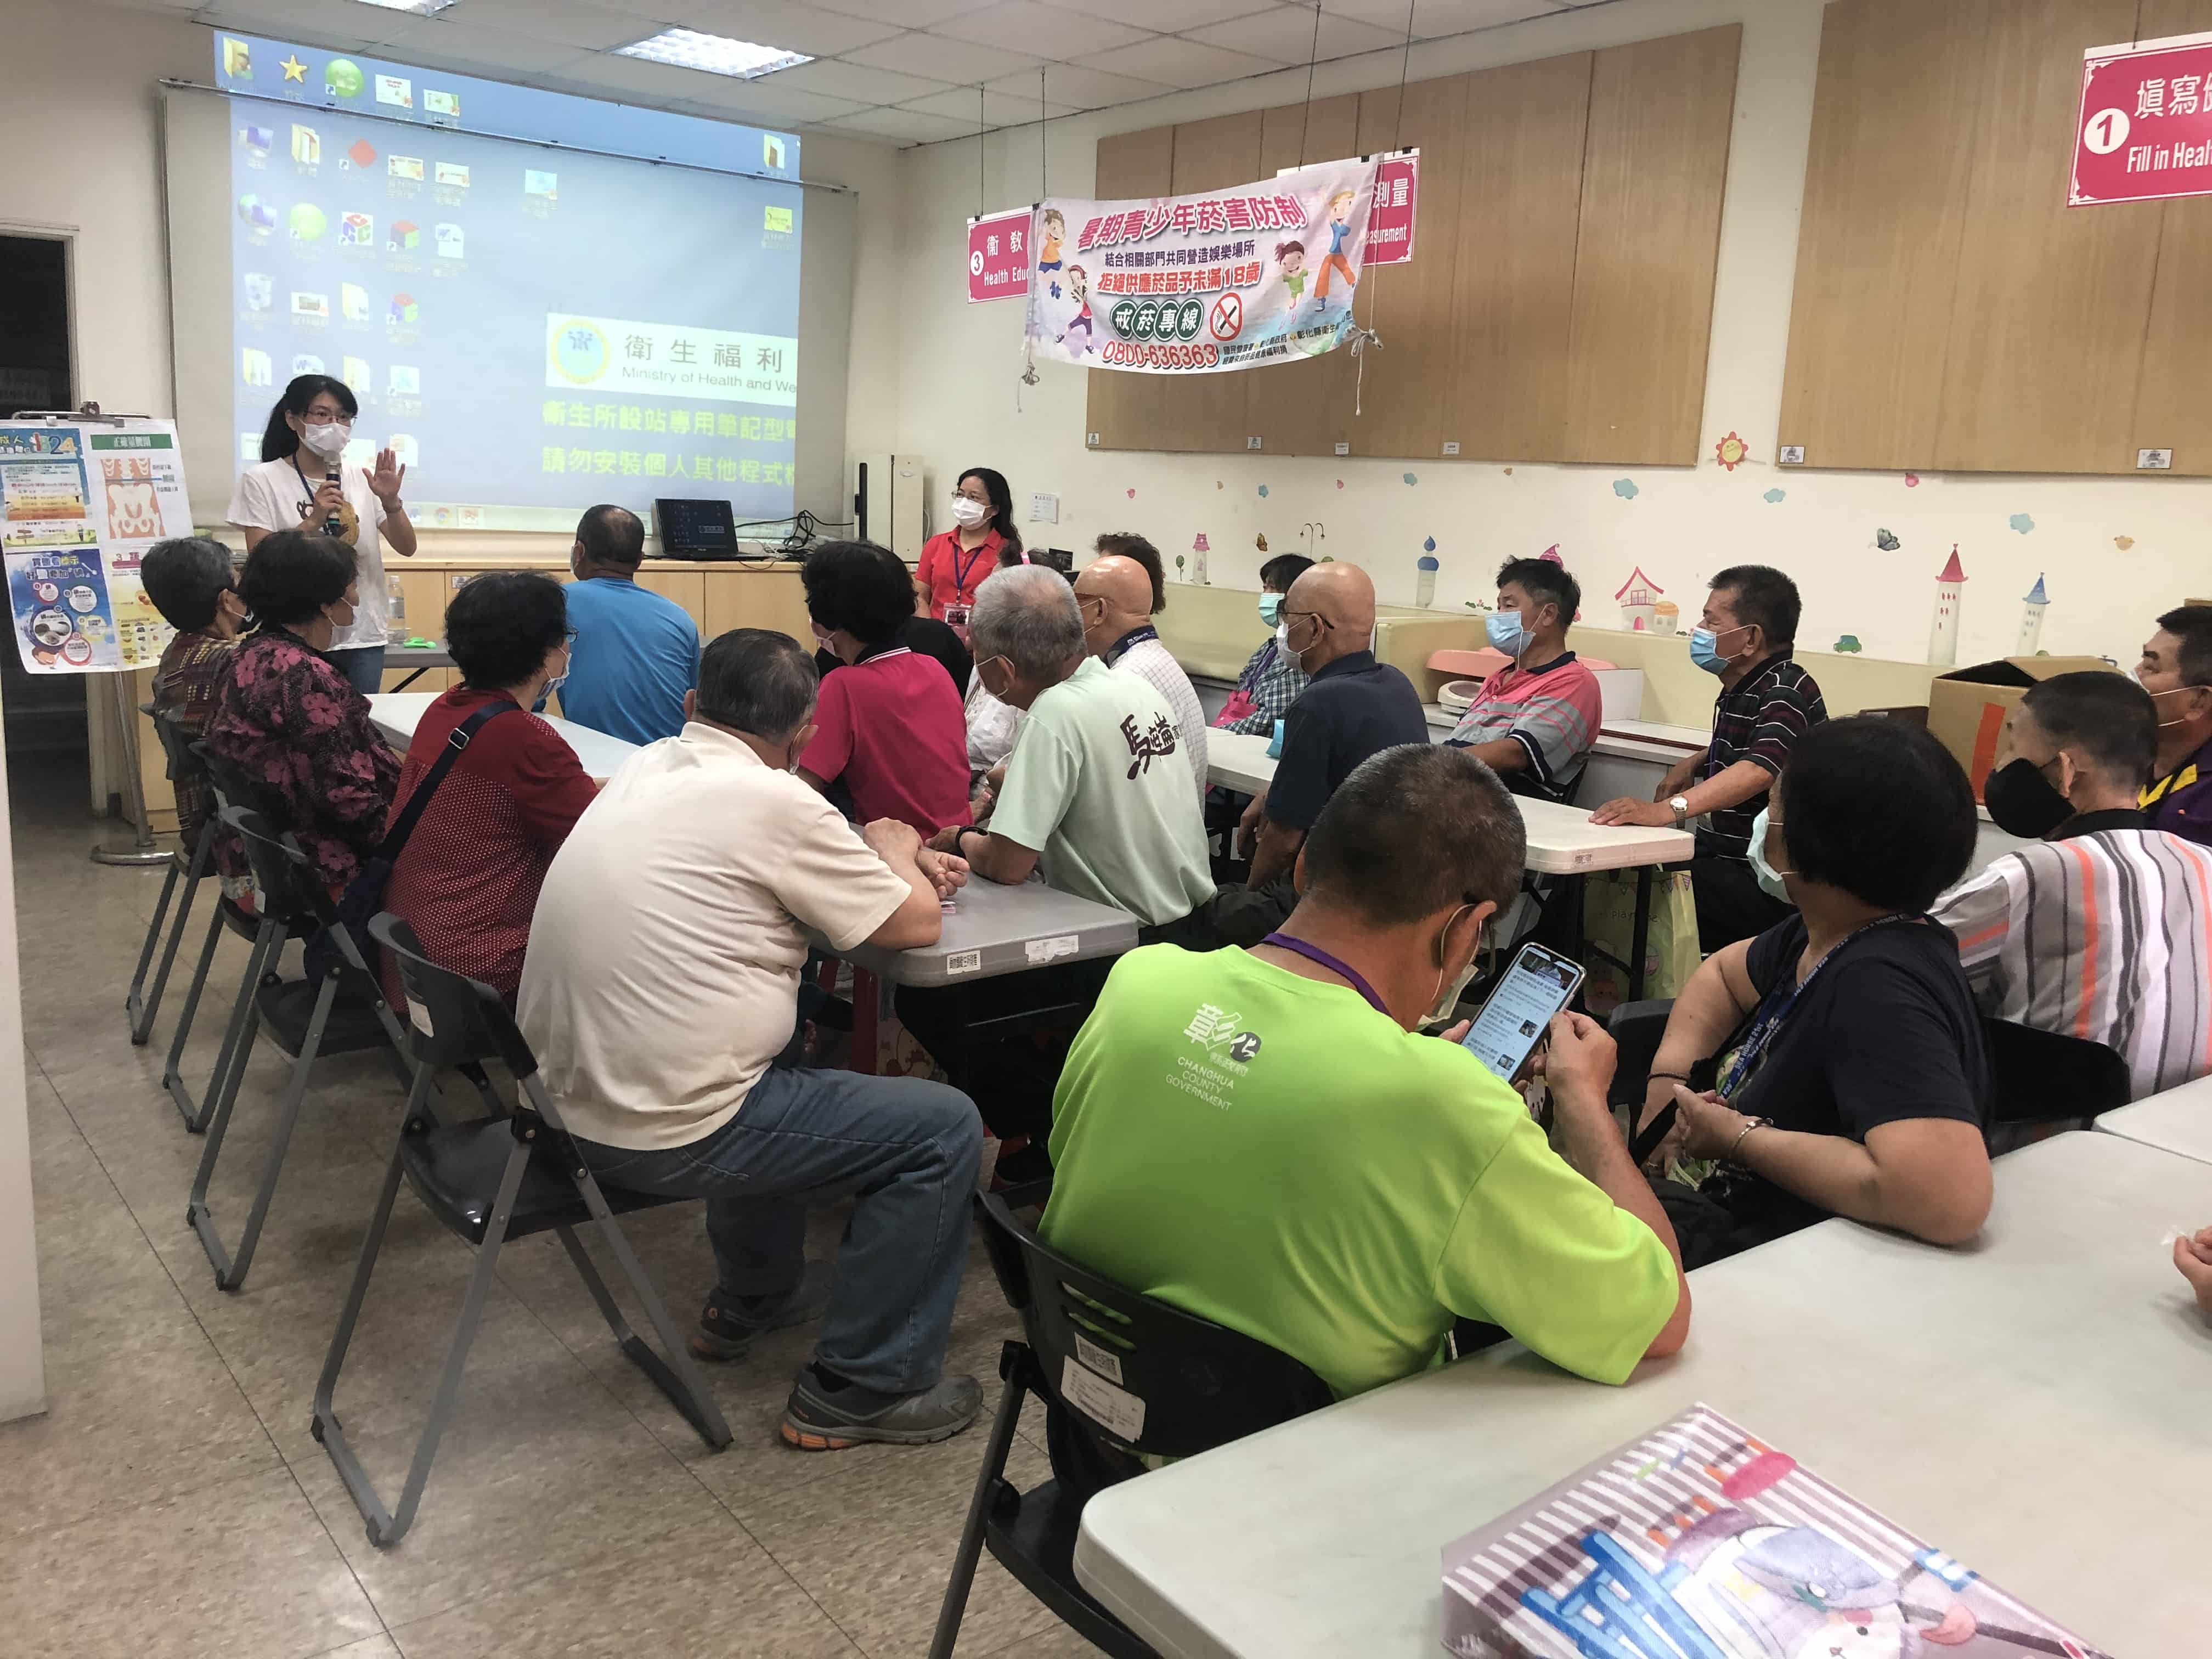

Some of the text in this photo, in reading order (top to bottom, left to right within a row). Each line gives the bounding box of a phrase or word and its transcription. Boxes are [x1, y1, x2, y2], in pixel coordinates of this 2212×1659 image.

[2096, 114, 2114, 147] 1
[2126, 139, 2212, 173] Fill in Heal
[1373, 178, 1409, 208] 測量
[1077, 195, 1307, 251] 暑期青少年菸害防制
[1104, 239, 1255, 268] 結合相關部門共同營造娛樂場所
[984, 268, 1008, 286] Health
[1097, 261, 1262, 295] 拒絕供應菸品予未滿18歲
[1114, 304, 1201, 332] 戒菸專線
[624, 334, 782, 374] 衛生福利
[1102, 340, 1220, 369] 0800-636363
[623, 366, 676, 383] Ministry
[681, 373, 694, 383] of
[698, 373, 742, 387] Health
[746, 379, 772, 391] and
[1177, 1056, 1234, 1089] CHANGHUA
[1182, 1070, 1223, 1094] COUNTY
[1166, 1074, 1233, 1111] GOVERNMENT
